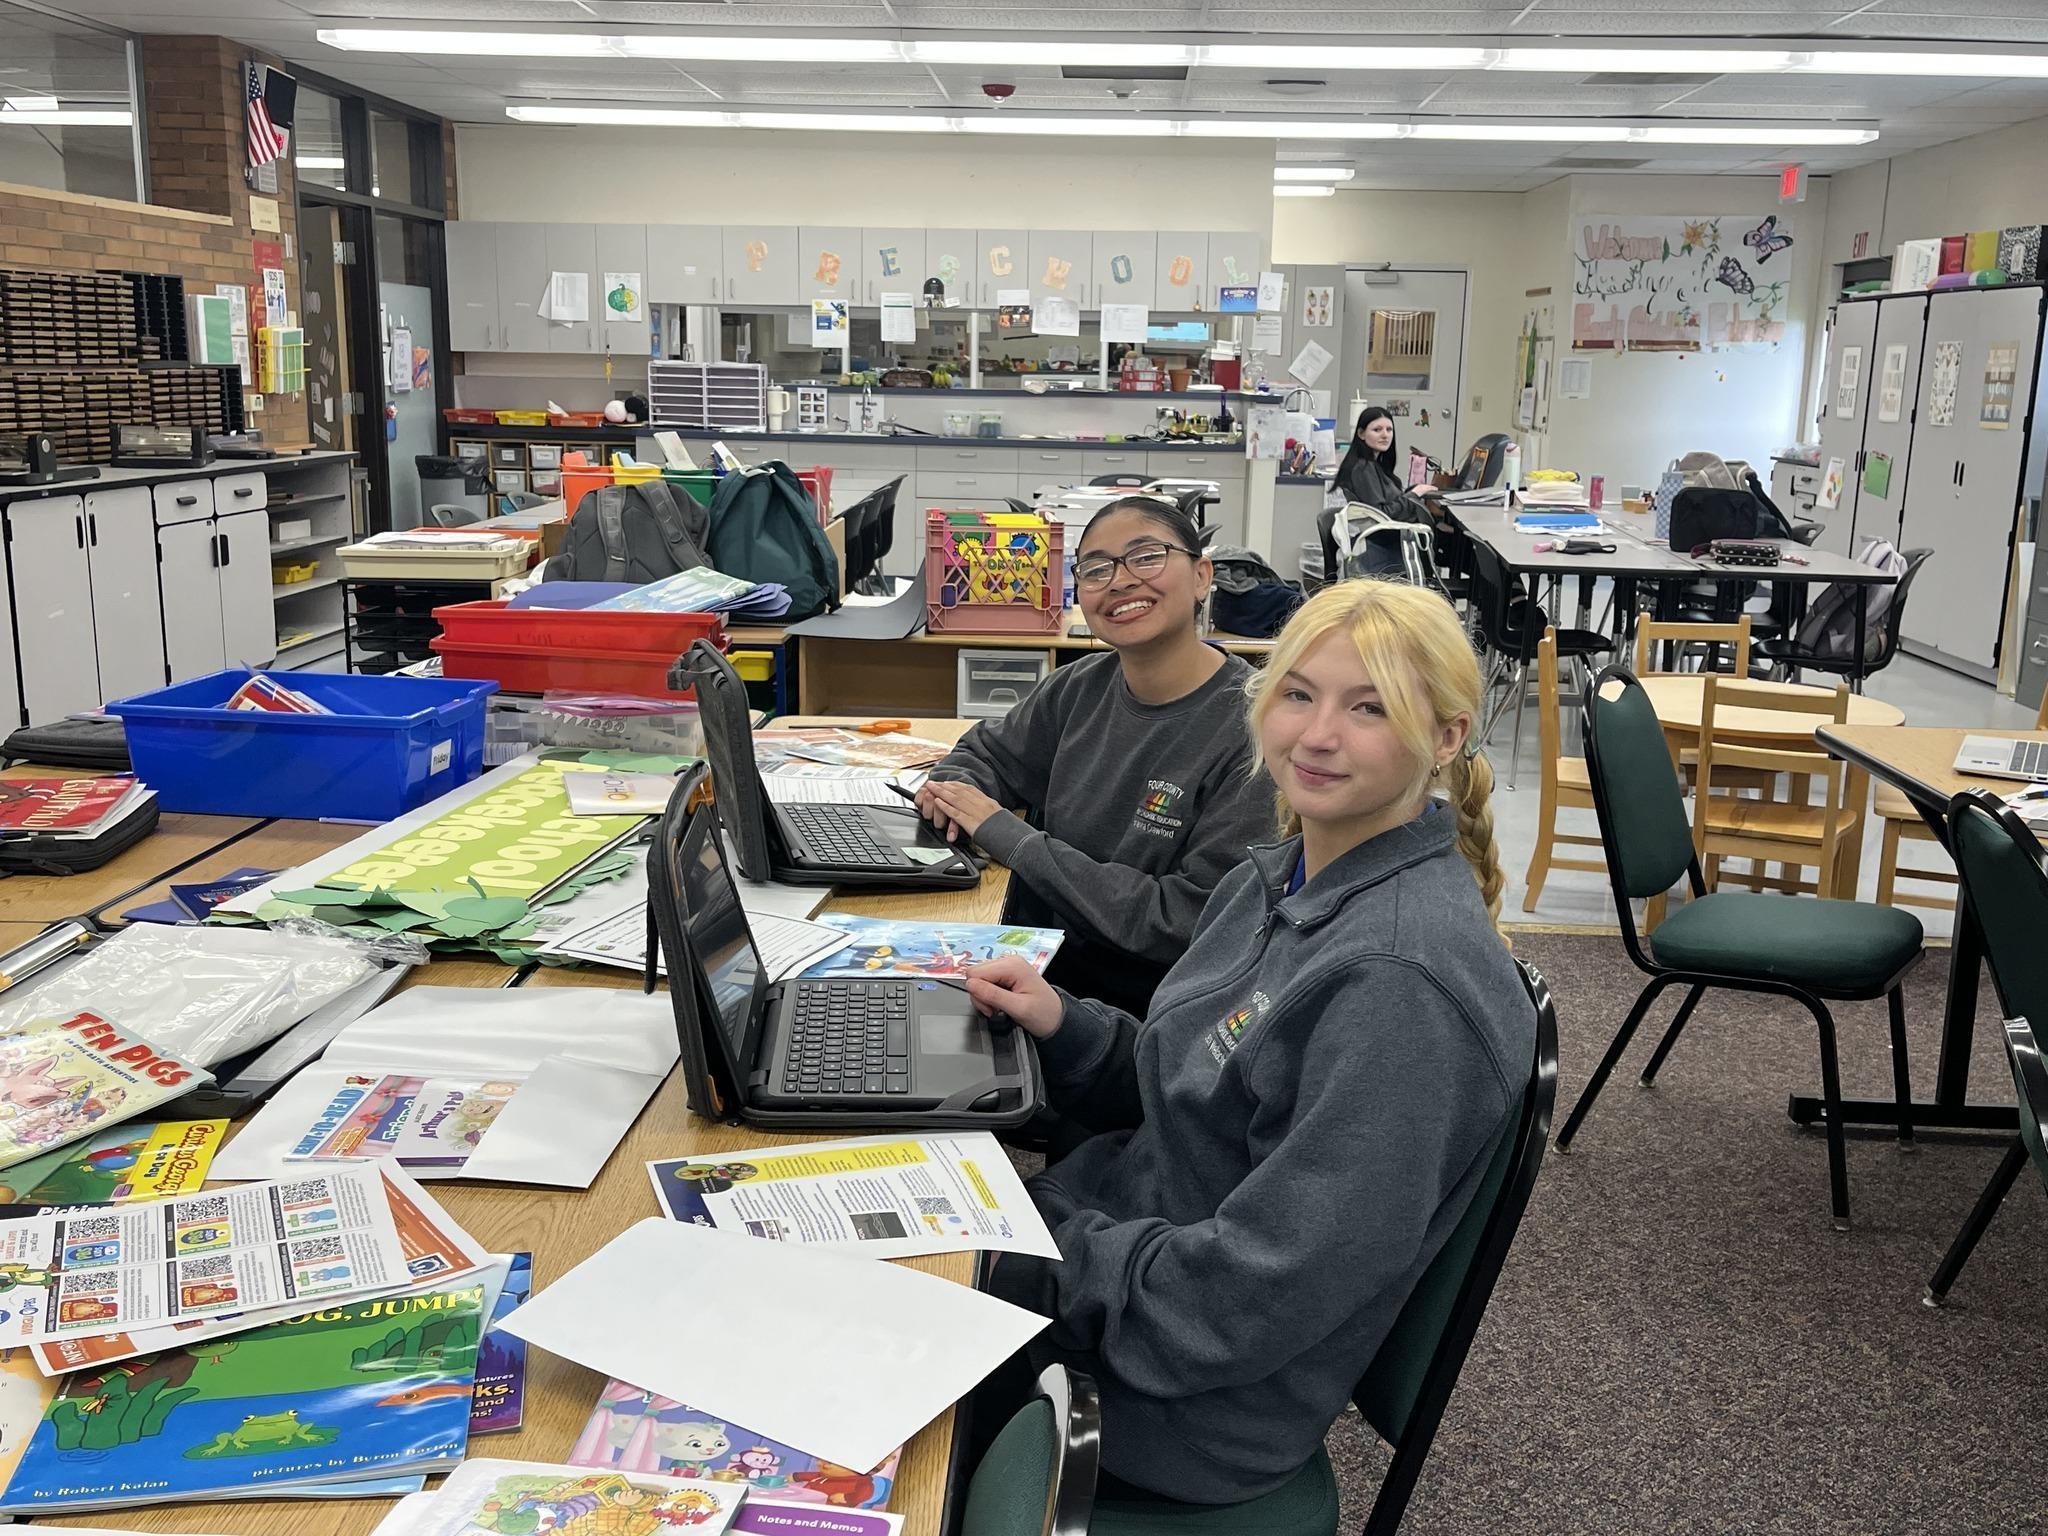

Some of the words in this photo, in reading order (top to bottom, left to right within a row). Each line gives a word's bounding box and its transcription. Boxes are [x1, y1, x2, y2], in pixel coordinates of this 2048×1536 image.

[1853, 231, 1869, 258] EXIT
[21, 779, 97, 827] GRUFFALO
[58, 1011, 127, 1052] TEN
[106, 1044, 194, 1087] PIGS
[102, 1063, 139, 1084] ADVENTURE
[153, 1158, 198, 1196] Georg
[360, 1285, 484, 1318] JUMP!
[474, 1383, 515, 1398] ks,
[475, 1397, 505, 1408] and
[470, 1408, 493, 1418] ns!
[252, 1461, 323, 1477] pictures
[328, 1459, 347, 1467] by
[353, 1451, 400, 1463] Byron
[405, 1442, 458, 1456] Barton
[34, 1489, 53, 1498] by
[57, 1484, 114, 1496] Robert
[120, 1480, 169, 1491] Kalan
[757, 1514, 793, 1526] Notes
[794, 1519, 818, 1528] and
[819, 1520, 864, 1534] Memos
